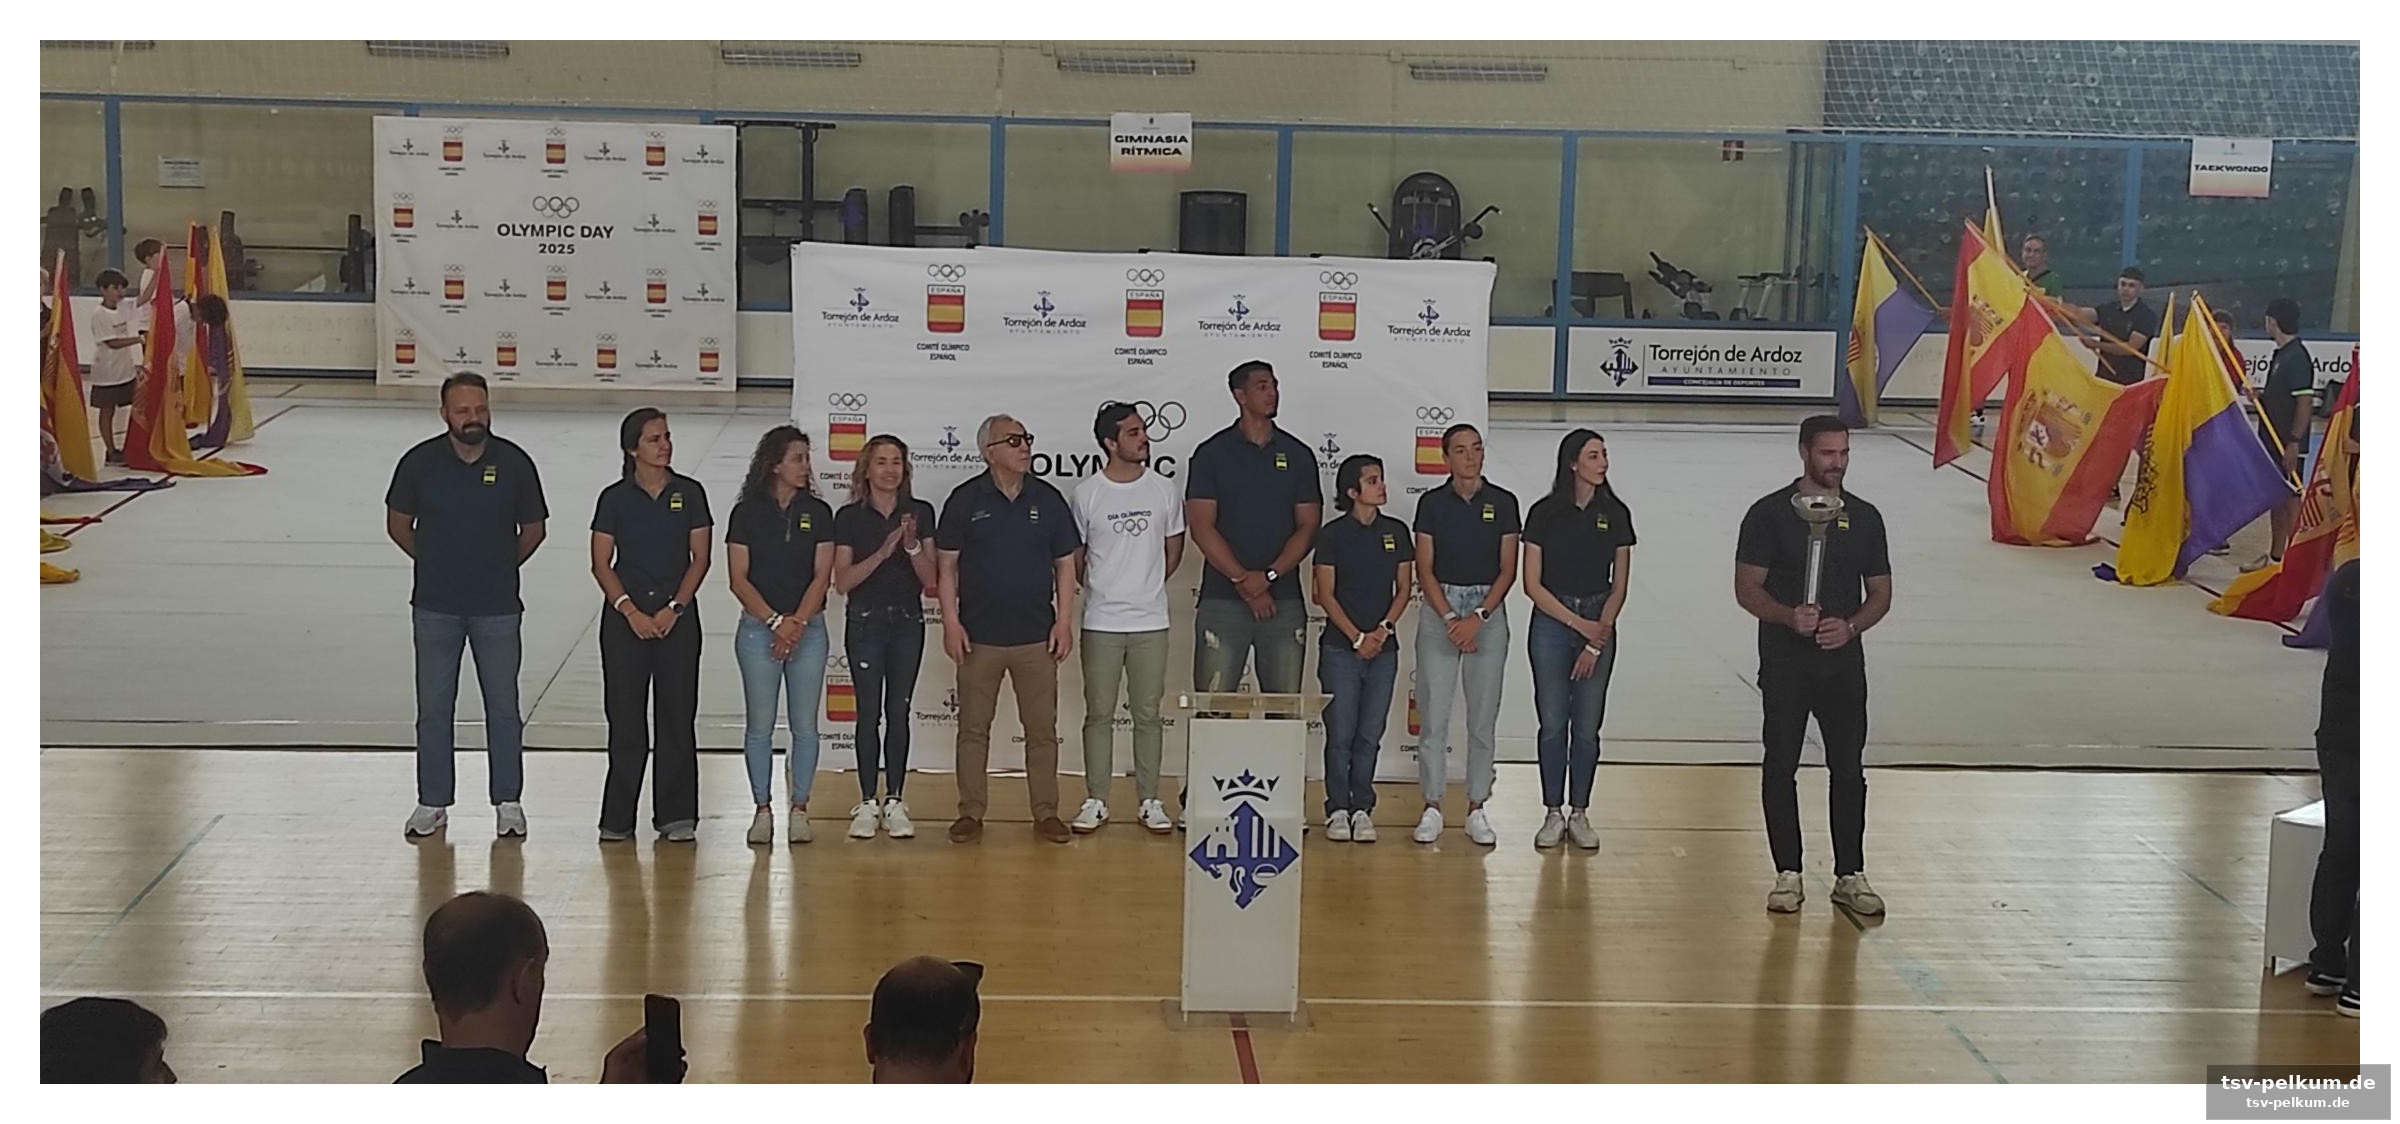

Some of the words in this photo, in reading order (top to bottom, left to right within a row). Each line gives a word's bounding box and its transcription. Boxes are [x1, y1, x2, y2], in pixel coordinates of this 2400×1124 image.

[1114, 135, 1188, 143] GIMNASIA
[1121, 146, 1182, 155] RÍTMICA
[2194, 164, 2268, 173] TAEKWONDO
[497, 223, 575, 238] OLYMPIC
[580, 225, 614, 239] DAY
[538, 243, 575, 255] 2025
[860, 312, 871, 322] de
[873, 313, 900, 322] Ardoz
[1044, 317, 1056, 328] de
[1058, 317, 1086, 328] Ardoz
[1239, 321, 1251, 331] de
[1253, 321, 1281, 332] Ardoz
[1428, 326, 1441, 336] de
[1443, 326, 1471, 337] Ardoz
[1649, 344, 1720, 366] Torrejón
[1724, 344, 1746, 362] de
[1750, 345, 1802, 363] Ardoz
[2312, 355, 2352, 373] Ardo
[1661, 366, 1791, 376] AYUNTAMIENTO
[950, 452, 962, 462] de
